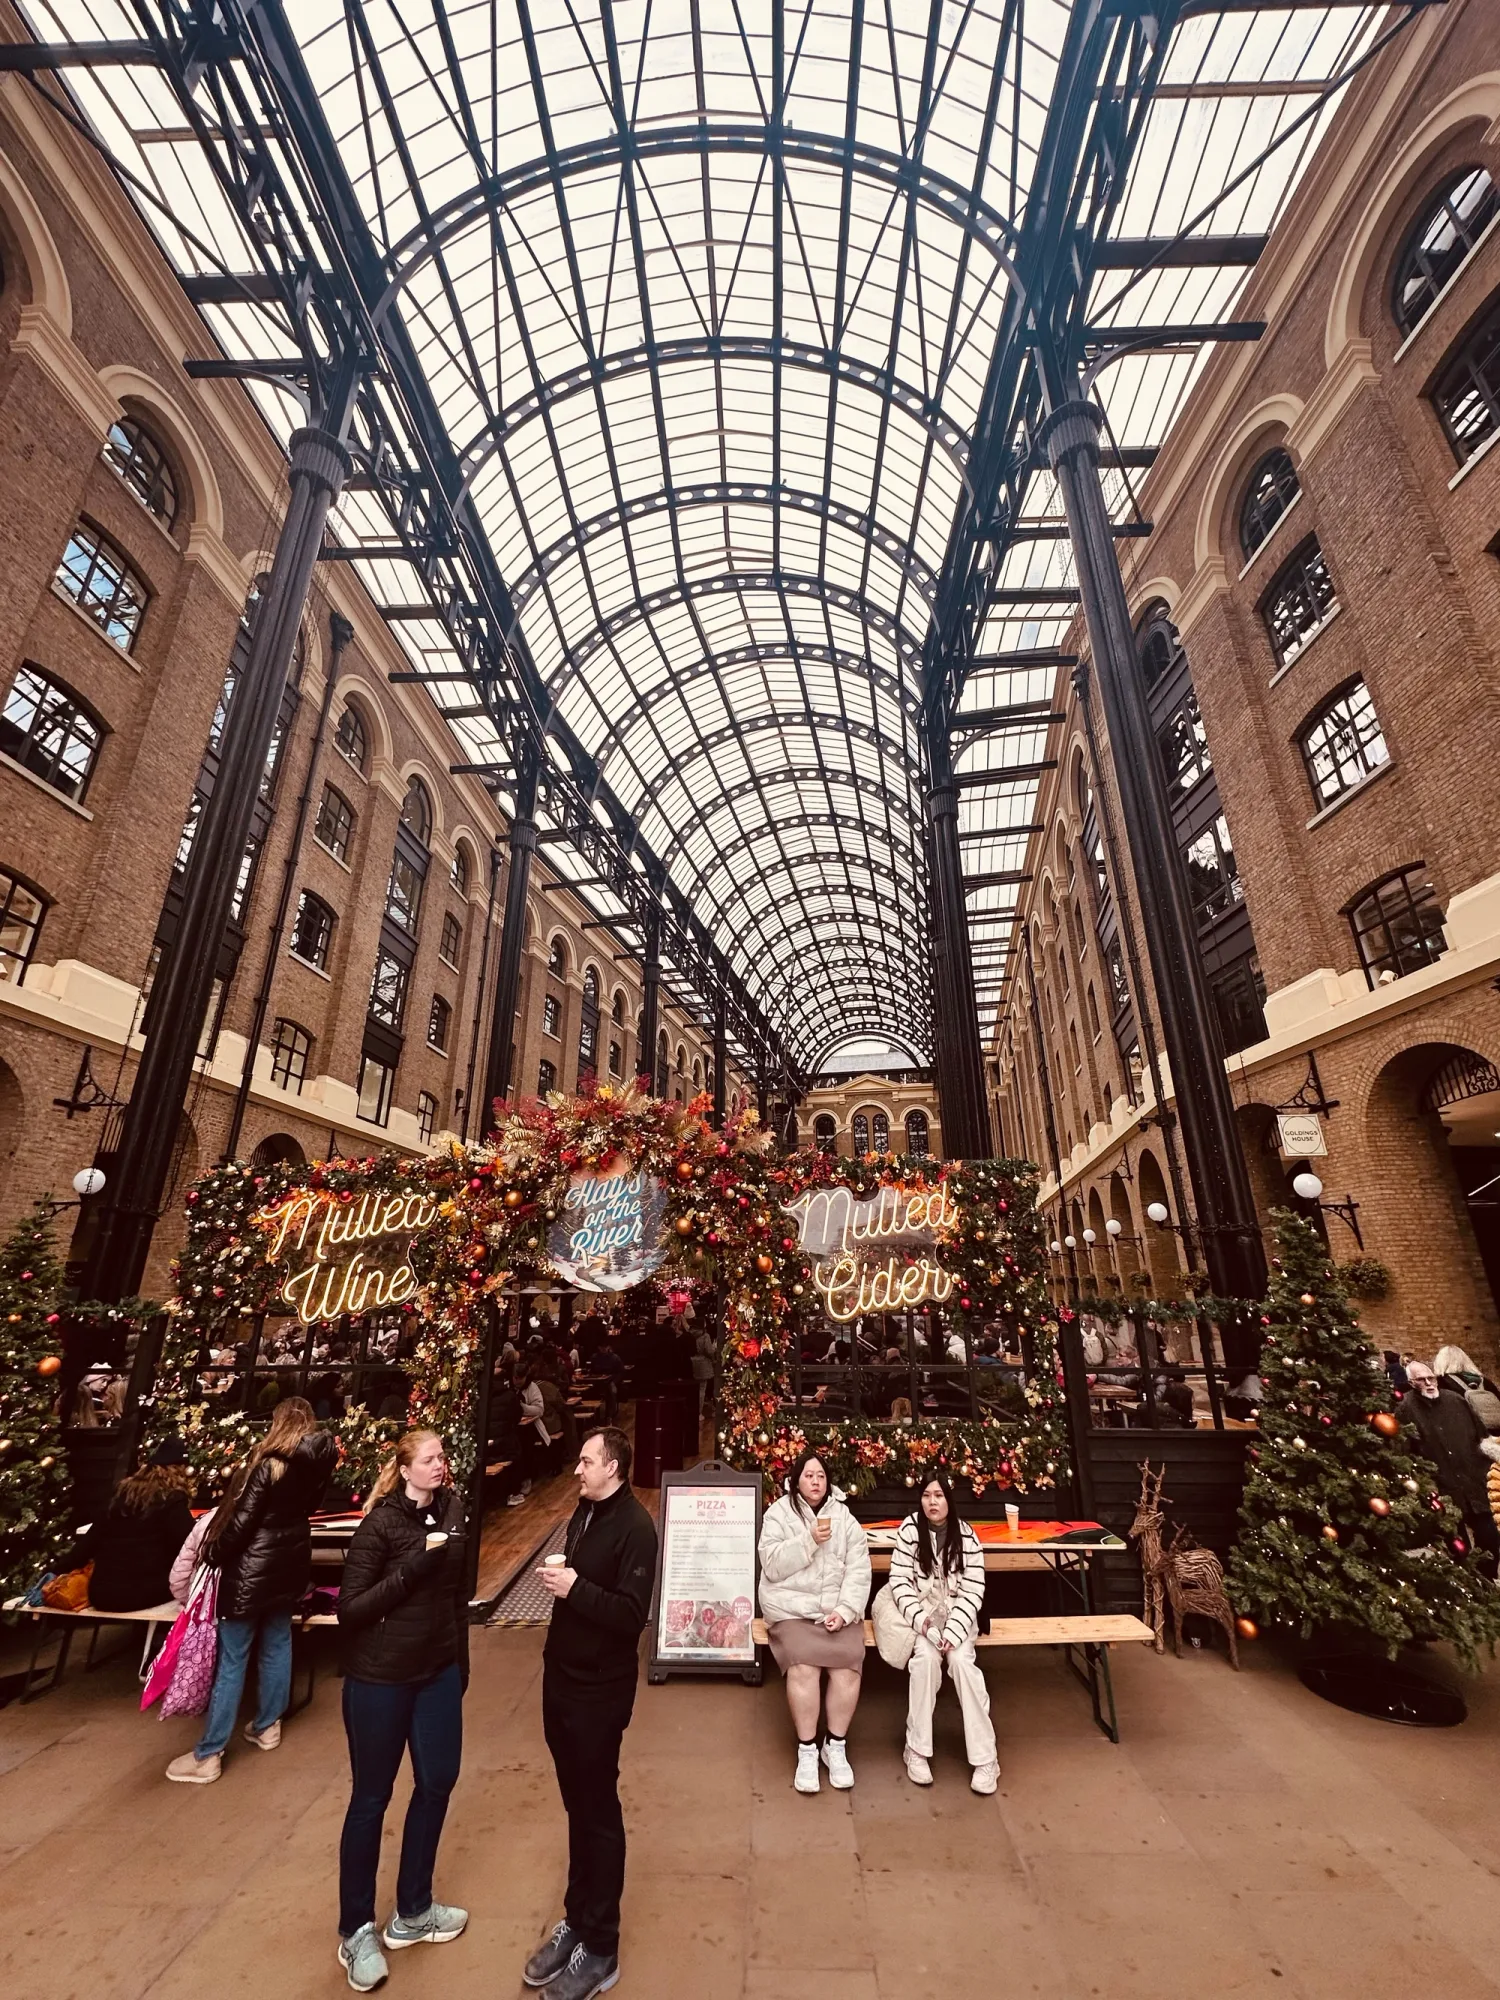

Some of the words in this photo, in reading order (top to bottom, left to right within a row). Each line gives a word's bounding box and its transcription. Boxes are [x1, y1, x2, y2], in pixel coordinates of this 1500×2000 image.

[569, 1214, 643, 1268] River
[583, 1208, 607, 1229] on
[611, 1195, 642, 1221] the
[779, 1181, 959, 1256] Mulled
[284, 1253, 415, 1322] Wine
[815, 1257, 951, 1320] Cider
[696, 1500, 727, 1510] PIZZA
